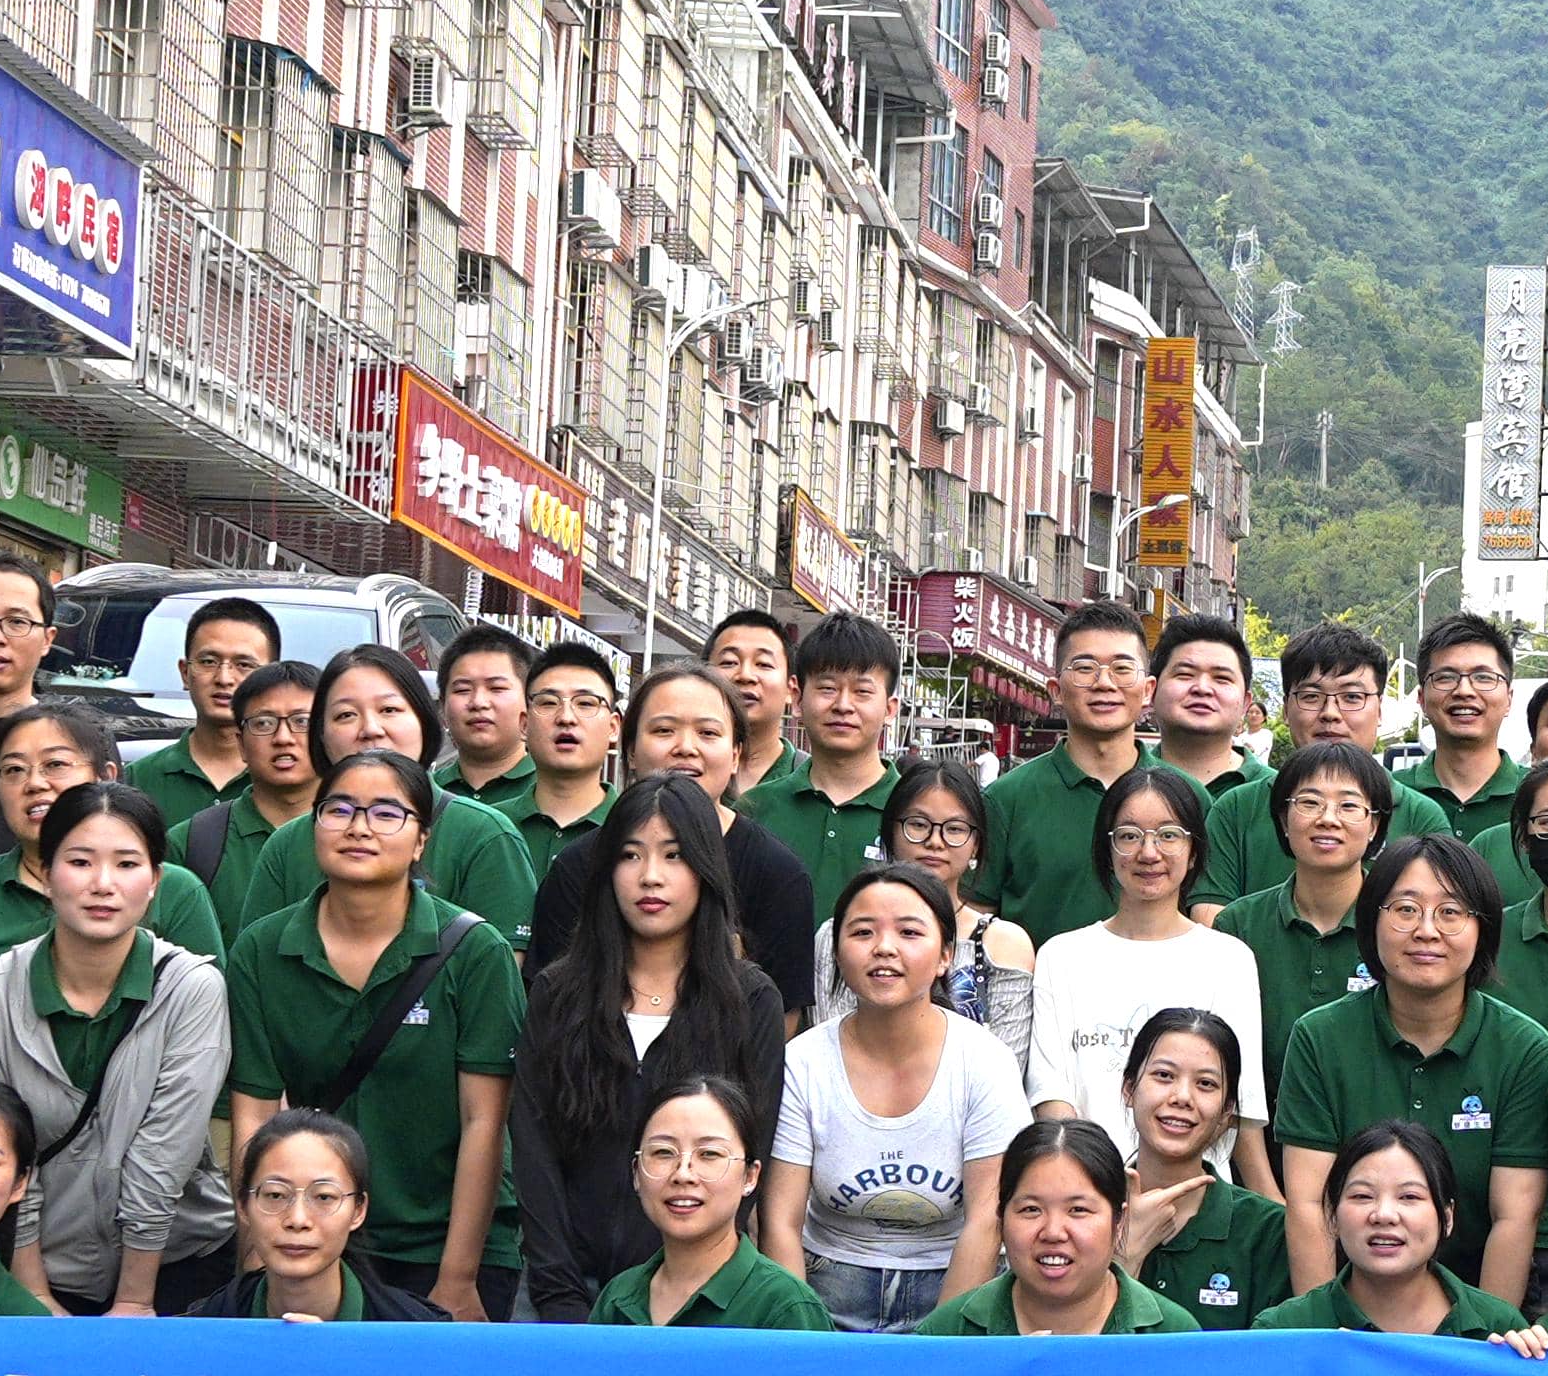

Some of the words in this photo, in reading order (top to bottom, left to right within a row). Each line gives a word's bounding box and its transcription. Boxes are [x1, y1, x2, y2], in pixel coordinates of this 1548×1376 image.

[29, 161, 120, 265] 湖畔民宿
[1148, 349, 1185, 527] 山水人家
[1489, 277, 1530, 500] 月亮湾宾馆
[952, 576, 978, 649] 柴火饭
[879, 1150, 904, 1161] THE
